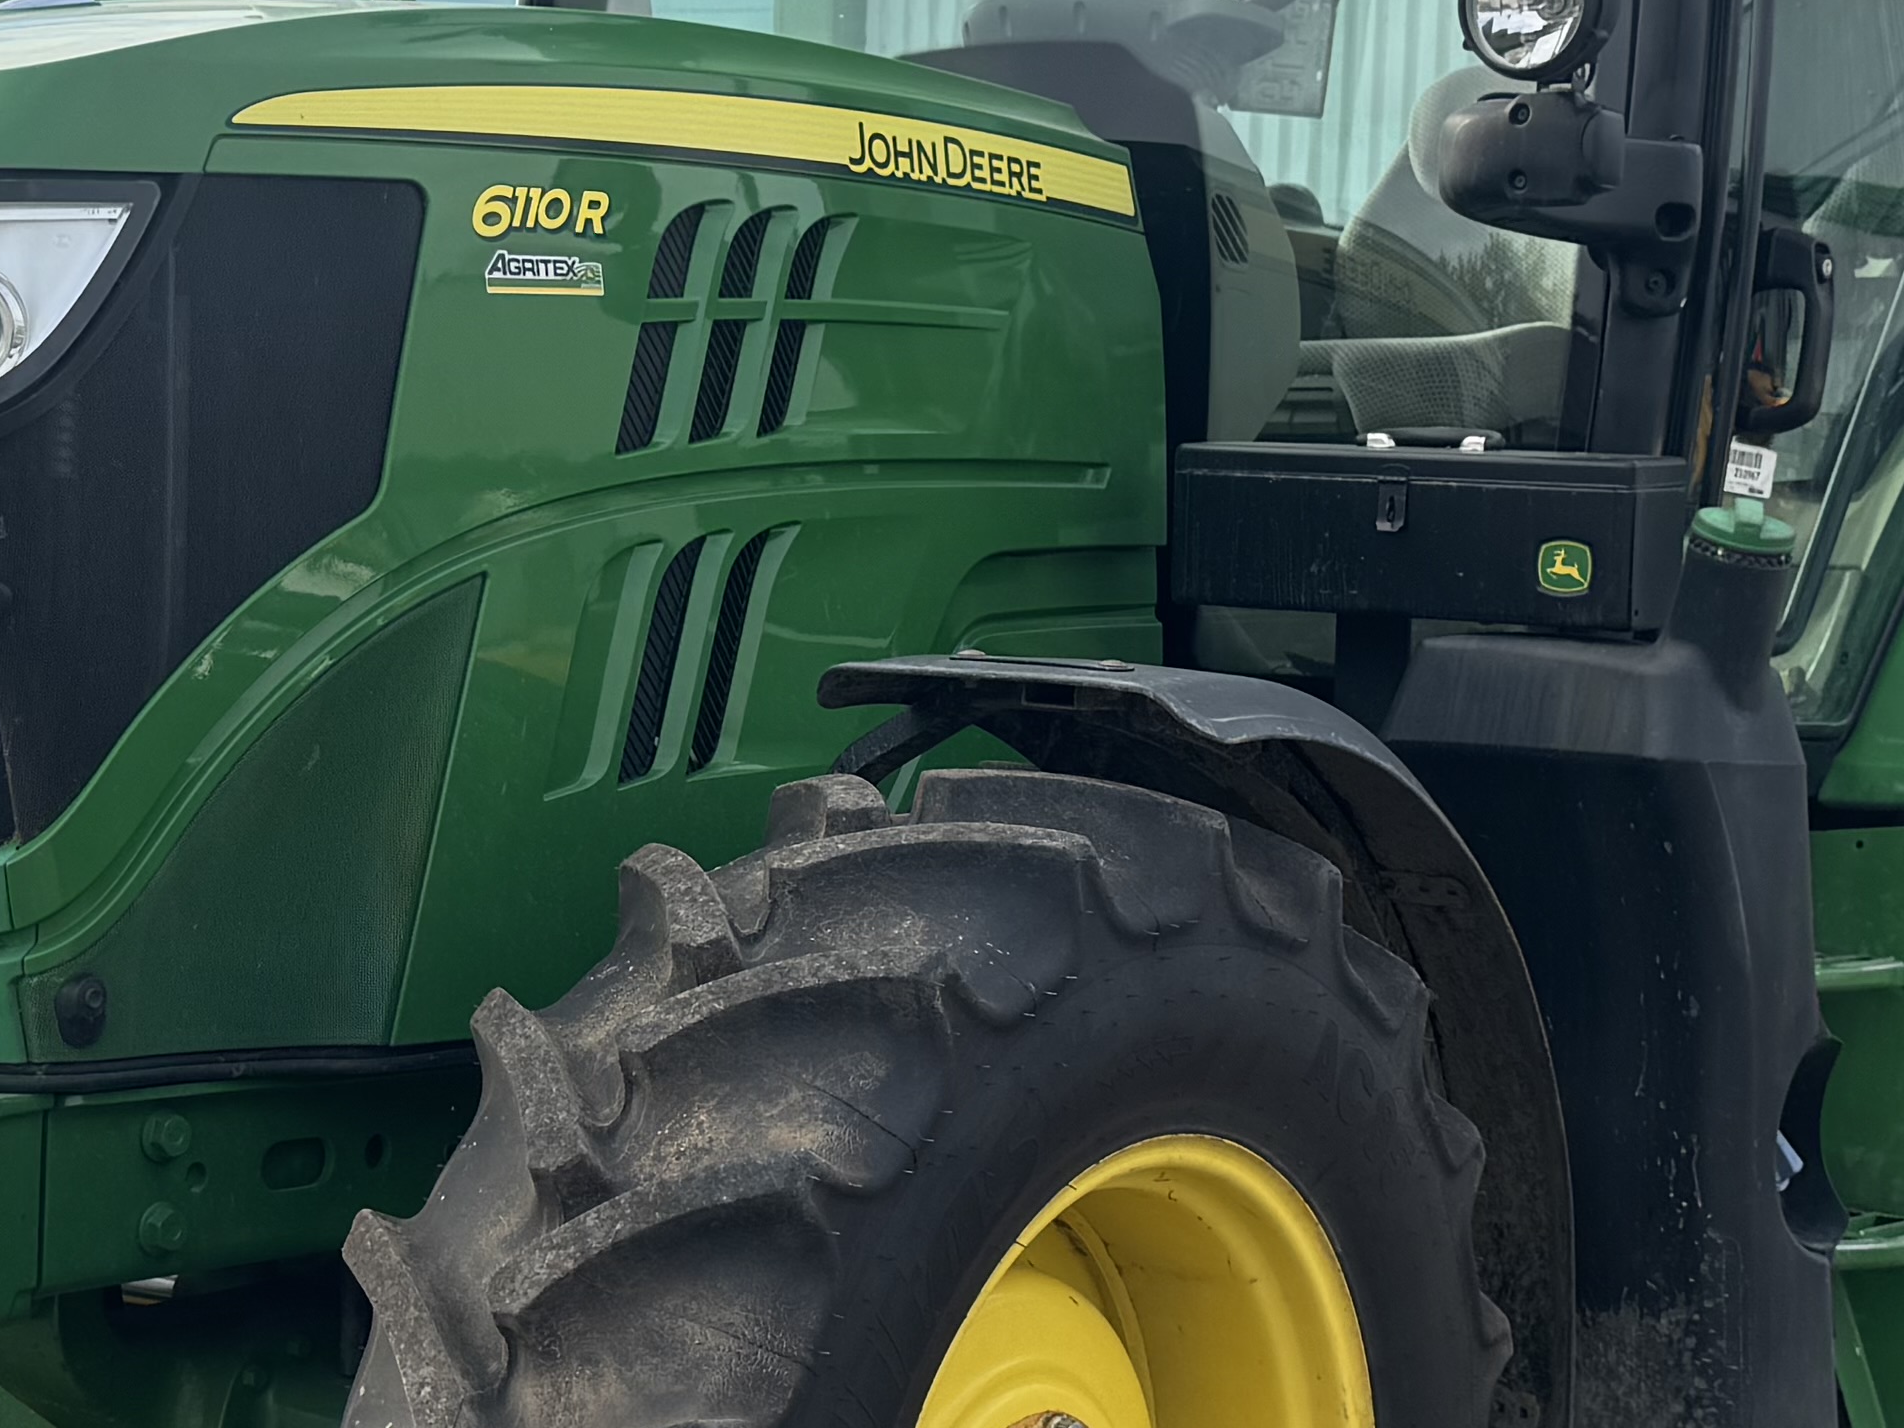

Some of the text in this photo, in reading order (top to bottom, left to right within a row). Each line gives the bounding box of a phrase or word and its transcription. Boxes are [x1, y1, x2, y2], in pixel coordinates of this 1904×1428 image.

[848, 121, 1044, 196] JOHN DEERE
[487, 252, 579, 277] AGRITEX
